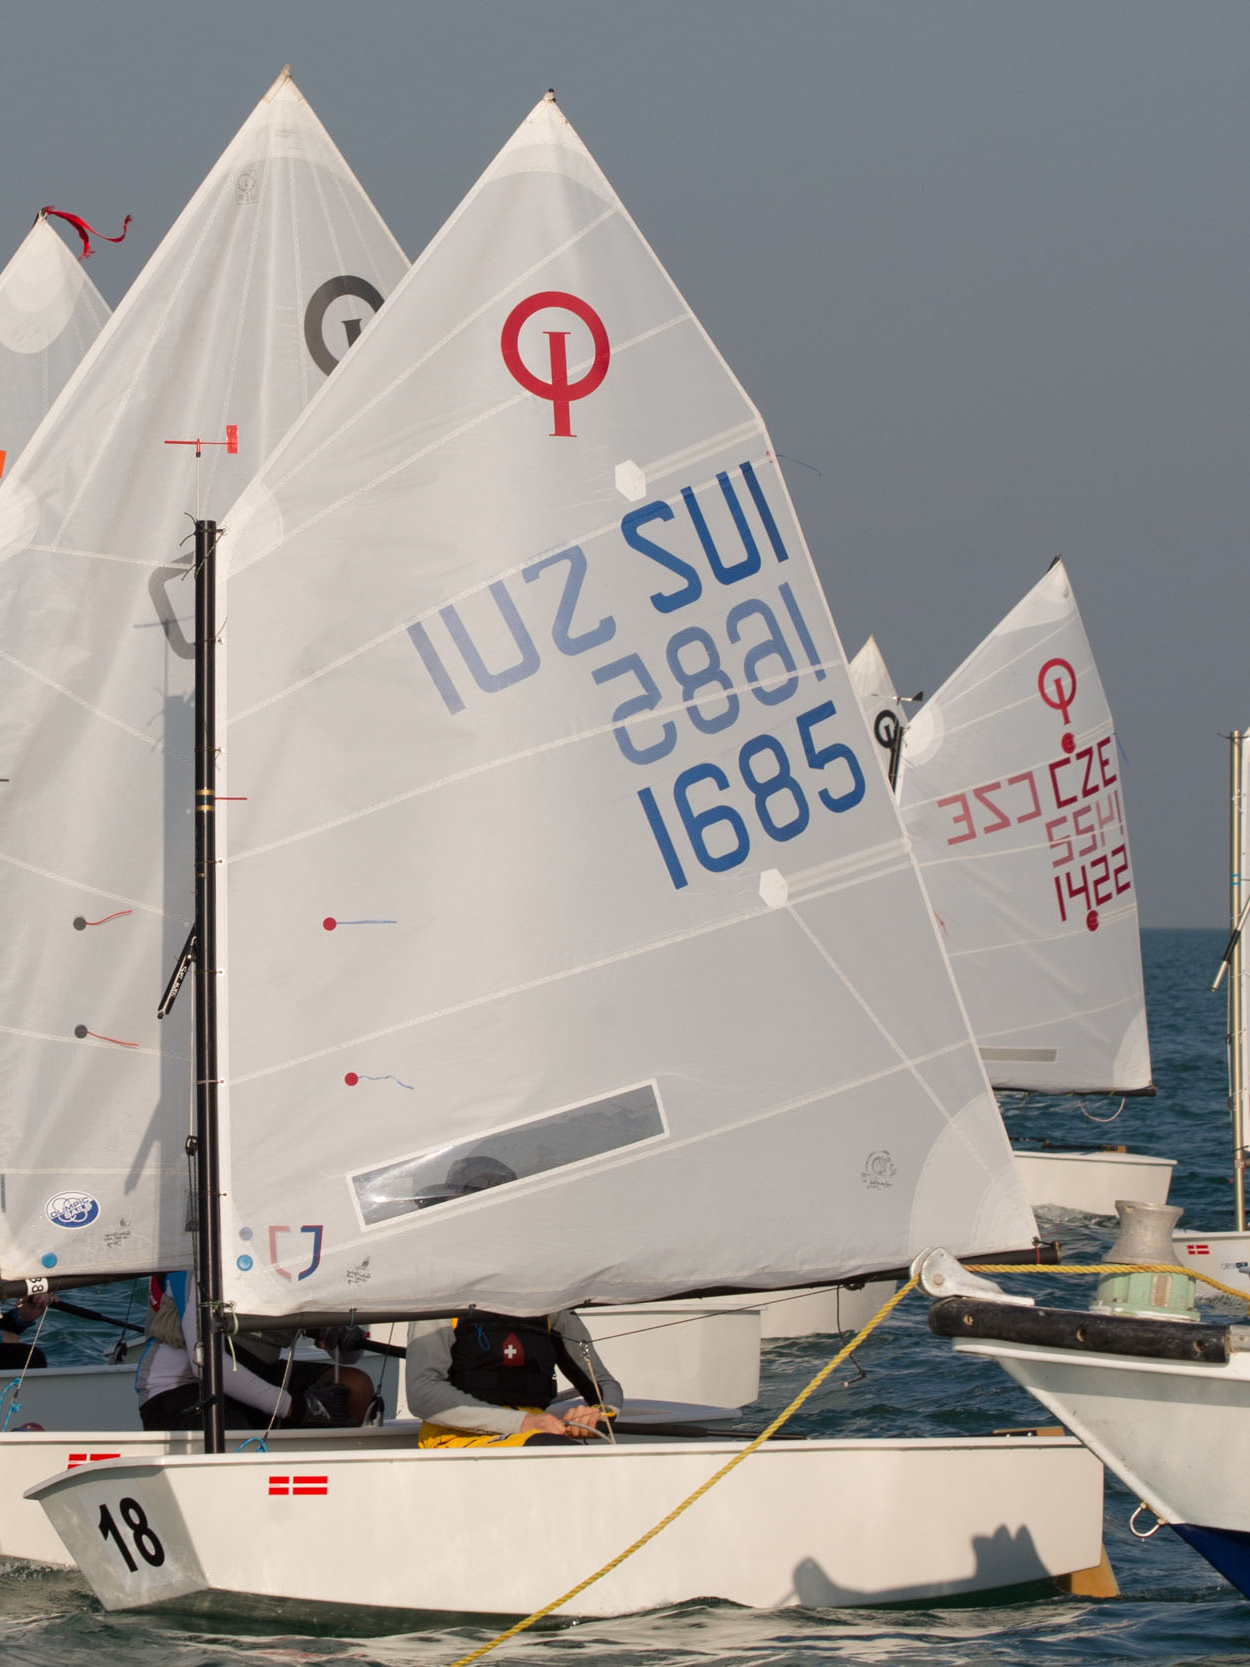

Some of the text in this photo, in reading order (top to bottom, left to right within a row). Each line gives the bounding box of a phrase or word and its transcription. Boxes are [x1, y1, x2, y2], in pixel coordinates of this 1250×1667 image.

[621, 461, 789, 613] SUI
[637, 700, 866, 890] 1685
[1048, 736, 1117, 810] CZE
[1054, 843, 1131, 922] 1422
[99, 1497, 166, 1573] 18
